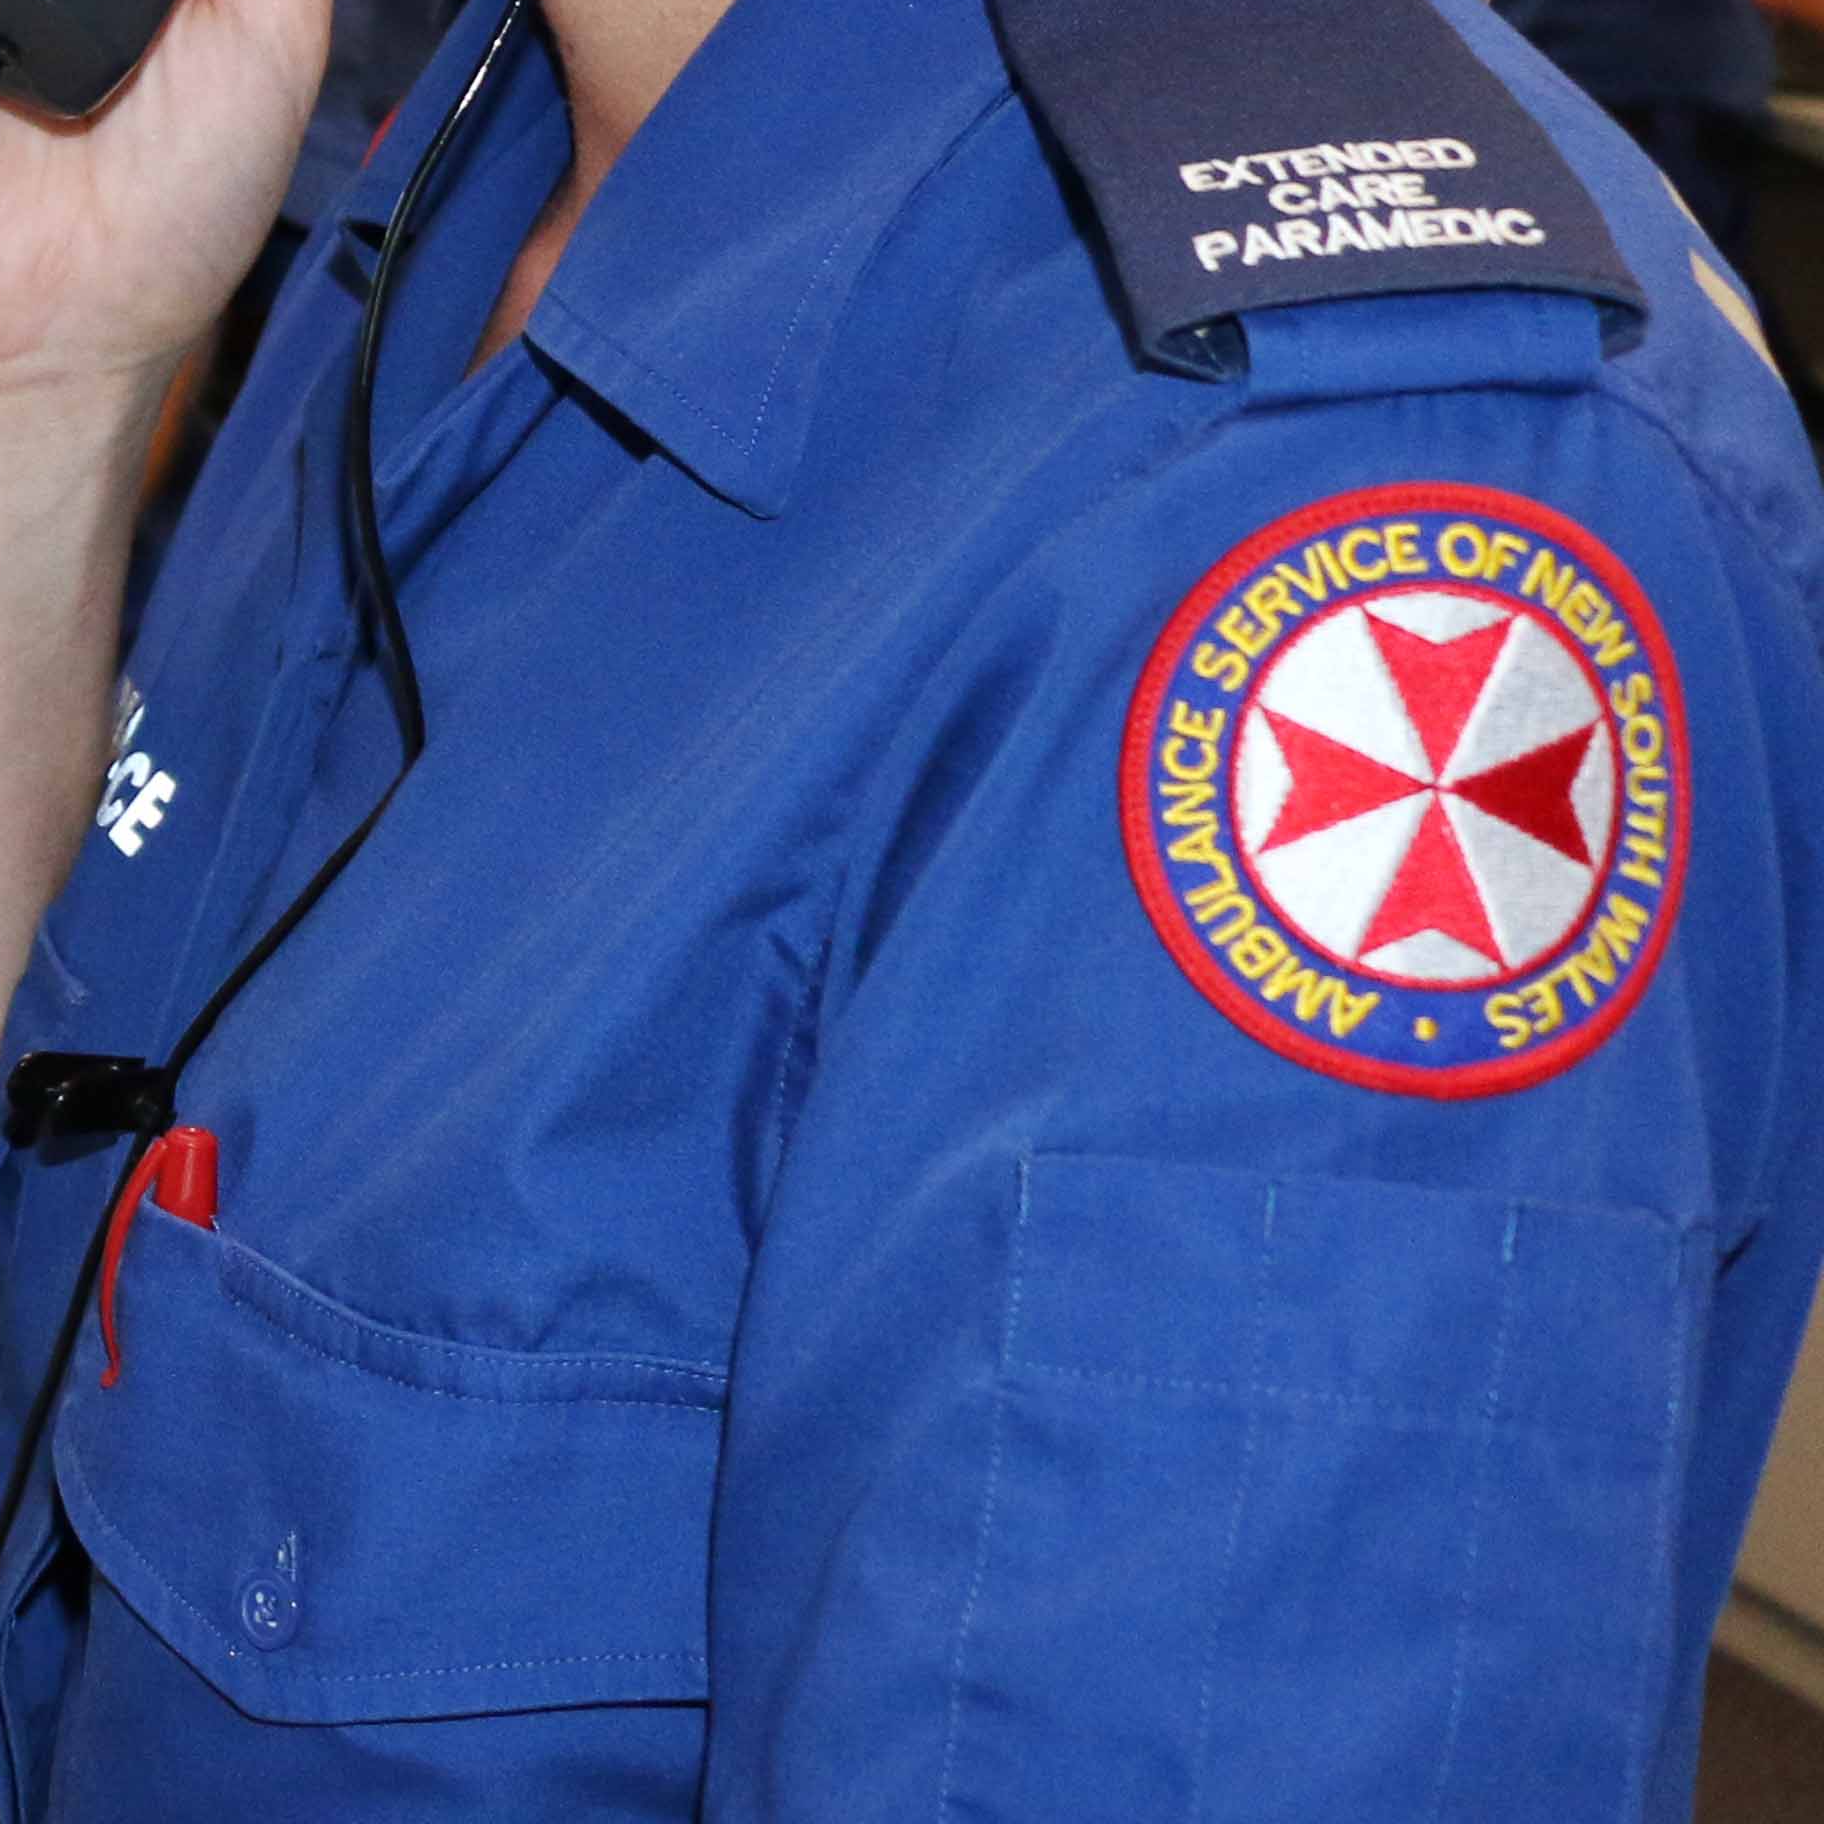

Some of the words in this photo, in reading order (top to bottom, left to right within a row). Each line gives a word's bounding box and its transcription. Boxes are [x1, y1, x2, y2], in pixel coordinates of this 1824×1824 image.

[1179, 137, 1477, 193] EXTENDED
[1267, 172, 1438, 216] CARE
[1191, 207, 1546, 273] PARAMEDIC
[1193, 523, 1428, 692] SERVICE
[1437, 521, 1529, 579] OF
[1520, 549, 1637, 669] NEW
[1609, 672, 1669, 887] SOUTH
[1159, 699, 1382, 1038] AMBULANCE
[1483, 892, 1651, 1050] WALES
